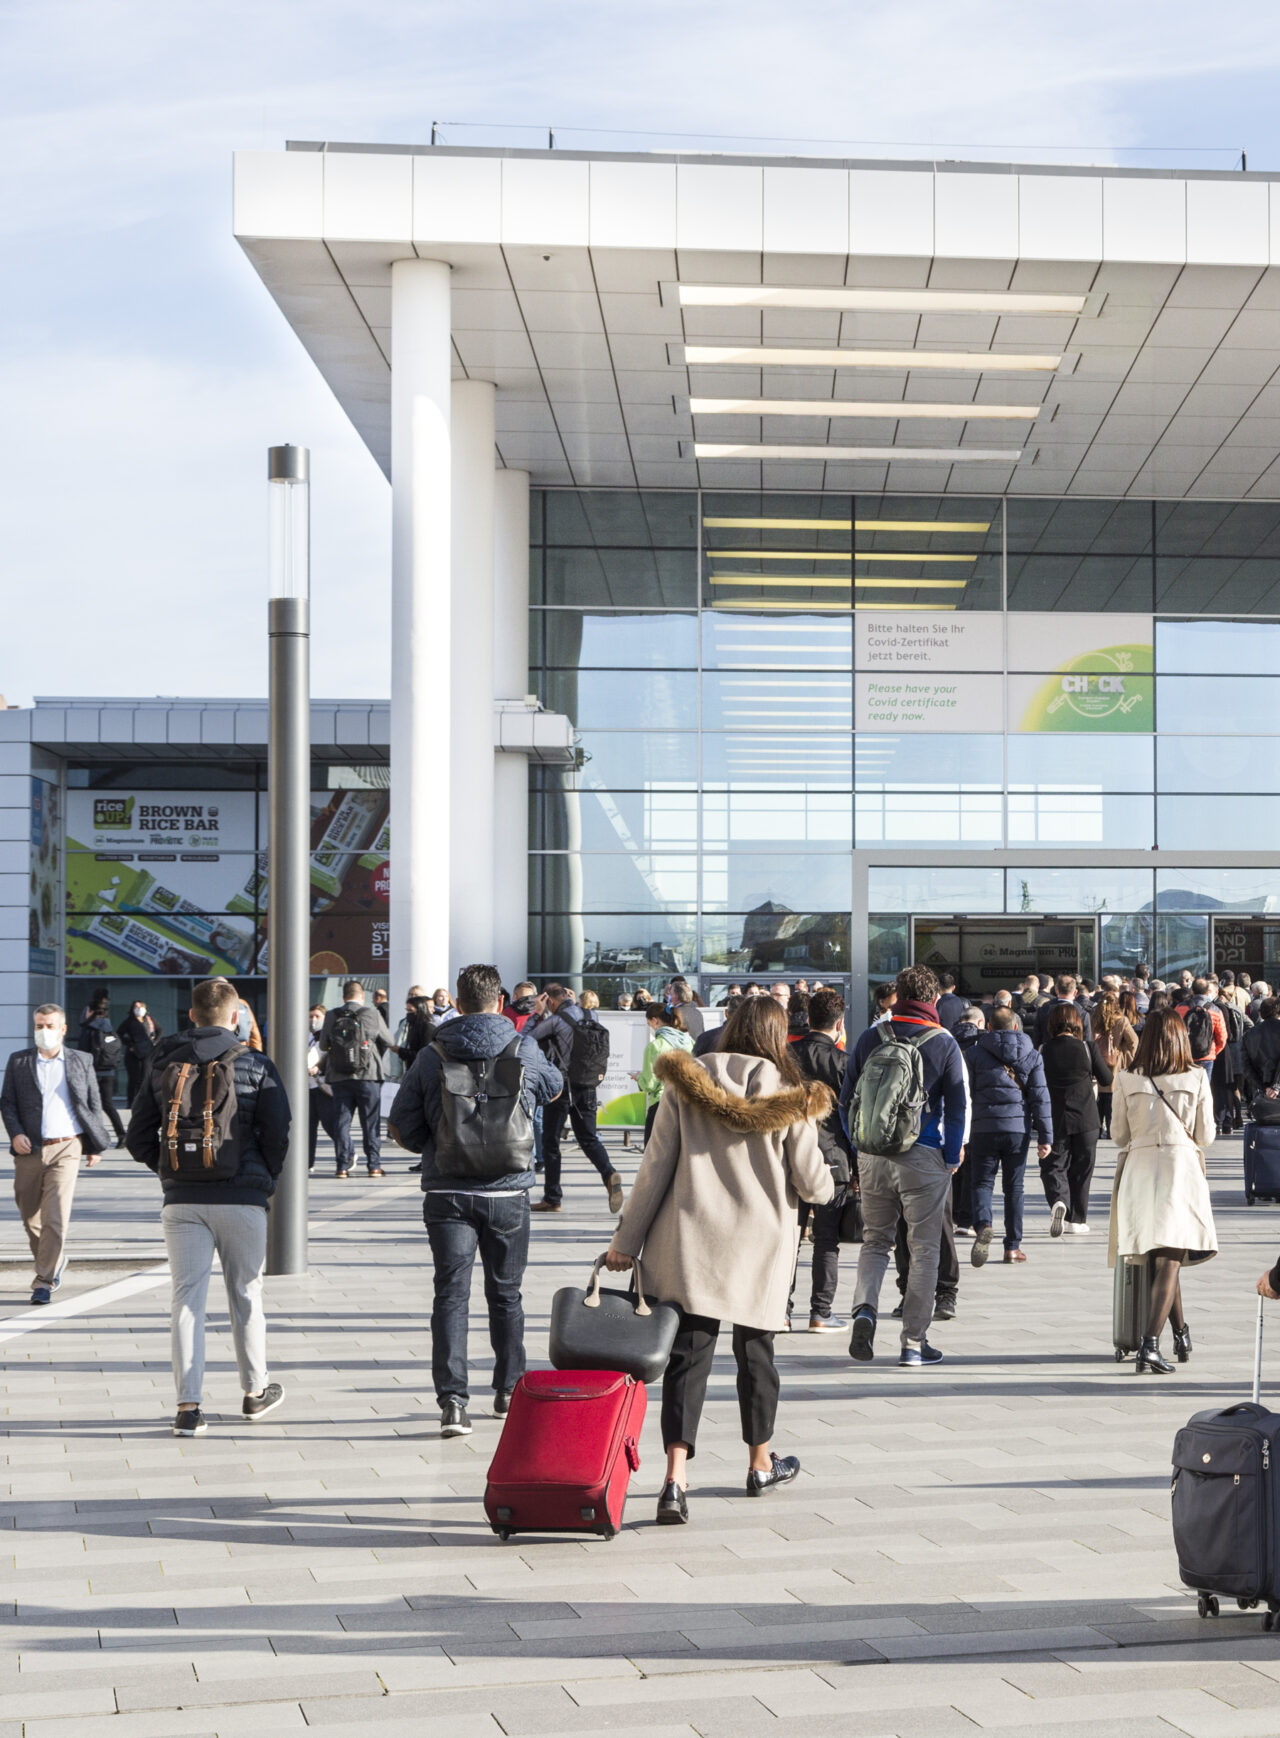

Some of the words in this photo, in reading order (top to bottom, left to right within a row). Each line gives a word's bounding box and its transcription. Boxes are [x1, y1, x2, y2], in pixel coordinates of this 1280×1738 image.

[868, 623, 893, 633] Bitte
[896, 623, 929, 633] halten
[932, 623, 948, 633] Sie
[951, 623, 965, 633] Ihr
[868, 637, 949, 647] Covid-Zertifikat
[867, 651, 893, 662] jetzt
[896, 651, 931, 661] bereit.
[868, 683, 902, 693] Please
[905, 684, 930, 693] have
[933, 685, 957, 695] your
[868, 697, 898, 707] Covid
[900, 697, 957, 708] certificate
[868, 711, 899, 722] ready
[901, 713, 925, 721] now.
[96, 801, 124, 811] rice
[139, 806, 204, 817] BROWN
[139, 819, 180, 831] RICE
[184, 819, 219, 831] BAR
[372, 922, 390, 930] VISI
[372, 931, 390, 942] ST
[1214, 934, 1247, 946] AND
[372, 943, 390, 956] B-
[1215, 948, 1246, 962] 021
